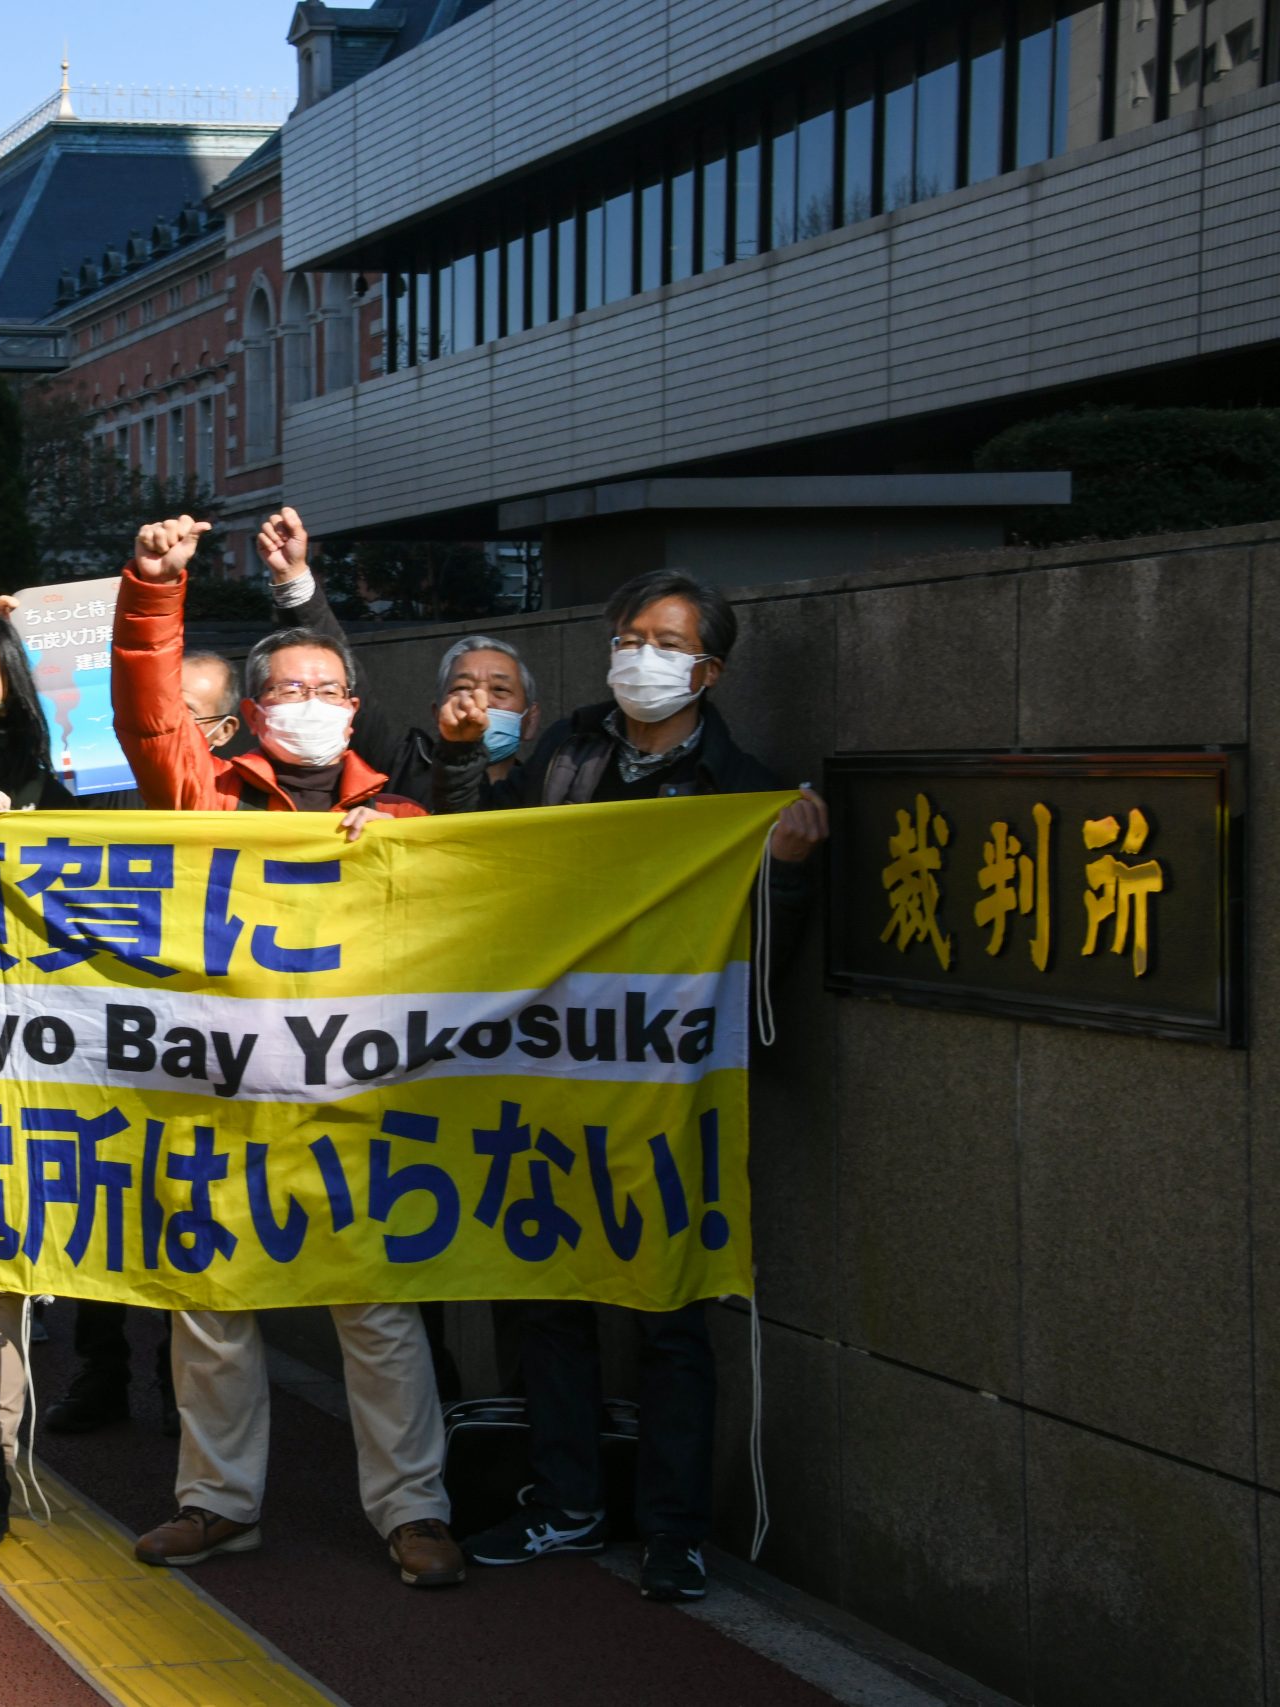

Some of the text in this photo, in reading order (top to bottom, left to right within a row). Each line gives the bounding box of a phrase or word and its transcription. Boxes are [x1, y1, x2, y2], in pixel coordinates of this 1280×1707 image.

[25, 625, 114, 651] 石炭火力発
[75, 651, 111, 671] 建設
[880, 793, 1163, 978] 裁判所
[106, 1004, 258, 1098] Bay
[284, 991, 716, 1085] Yokosuka
